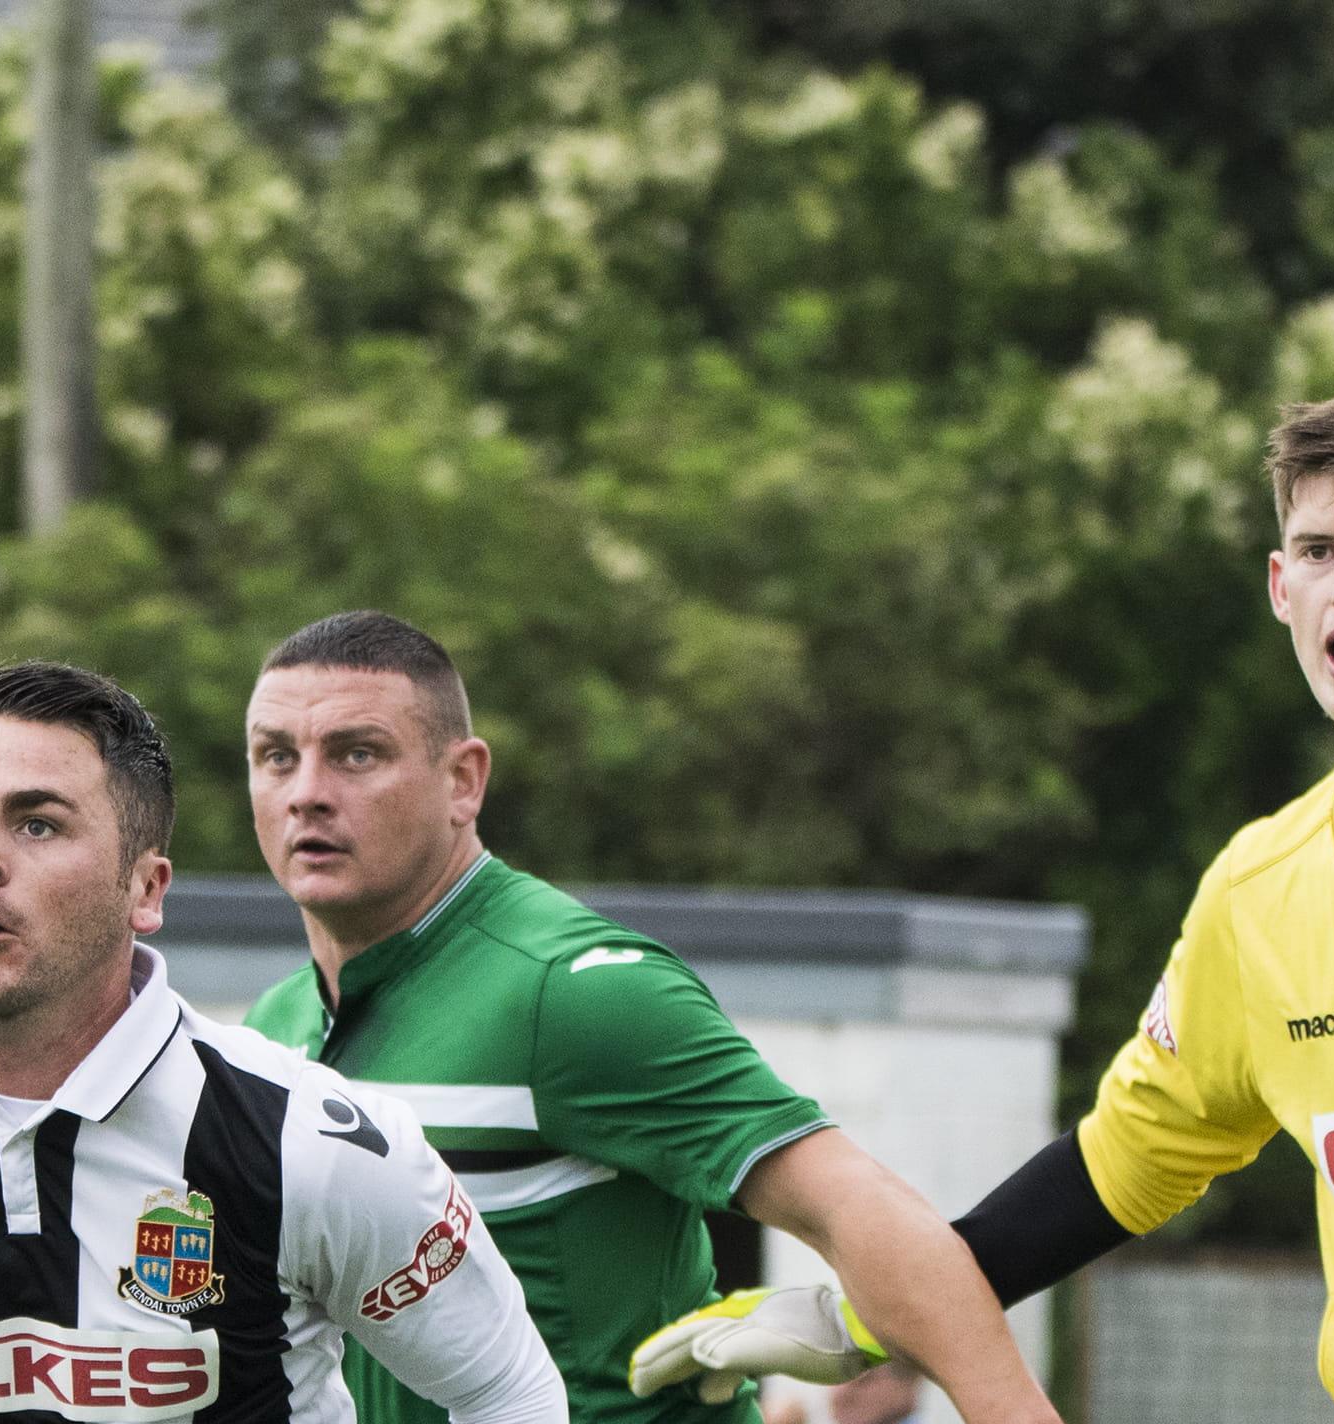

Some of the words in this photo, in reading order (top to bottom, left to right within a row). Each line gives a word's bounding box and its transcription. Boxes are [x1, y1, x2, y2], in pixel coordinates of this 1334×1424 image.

[423, 1227, 440, 1247] THE
[430, 1250, 463, 1282] LEAGUE
[128, 1284, 165, 1312] KENDAL
[166, 1300, 199, 1314] TOWN
